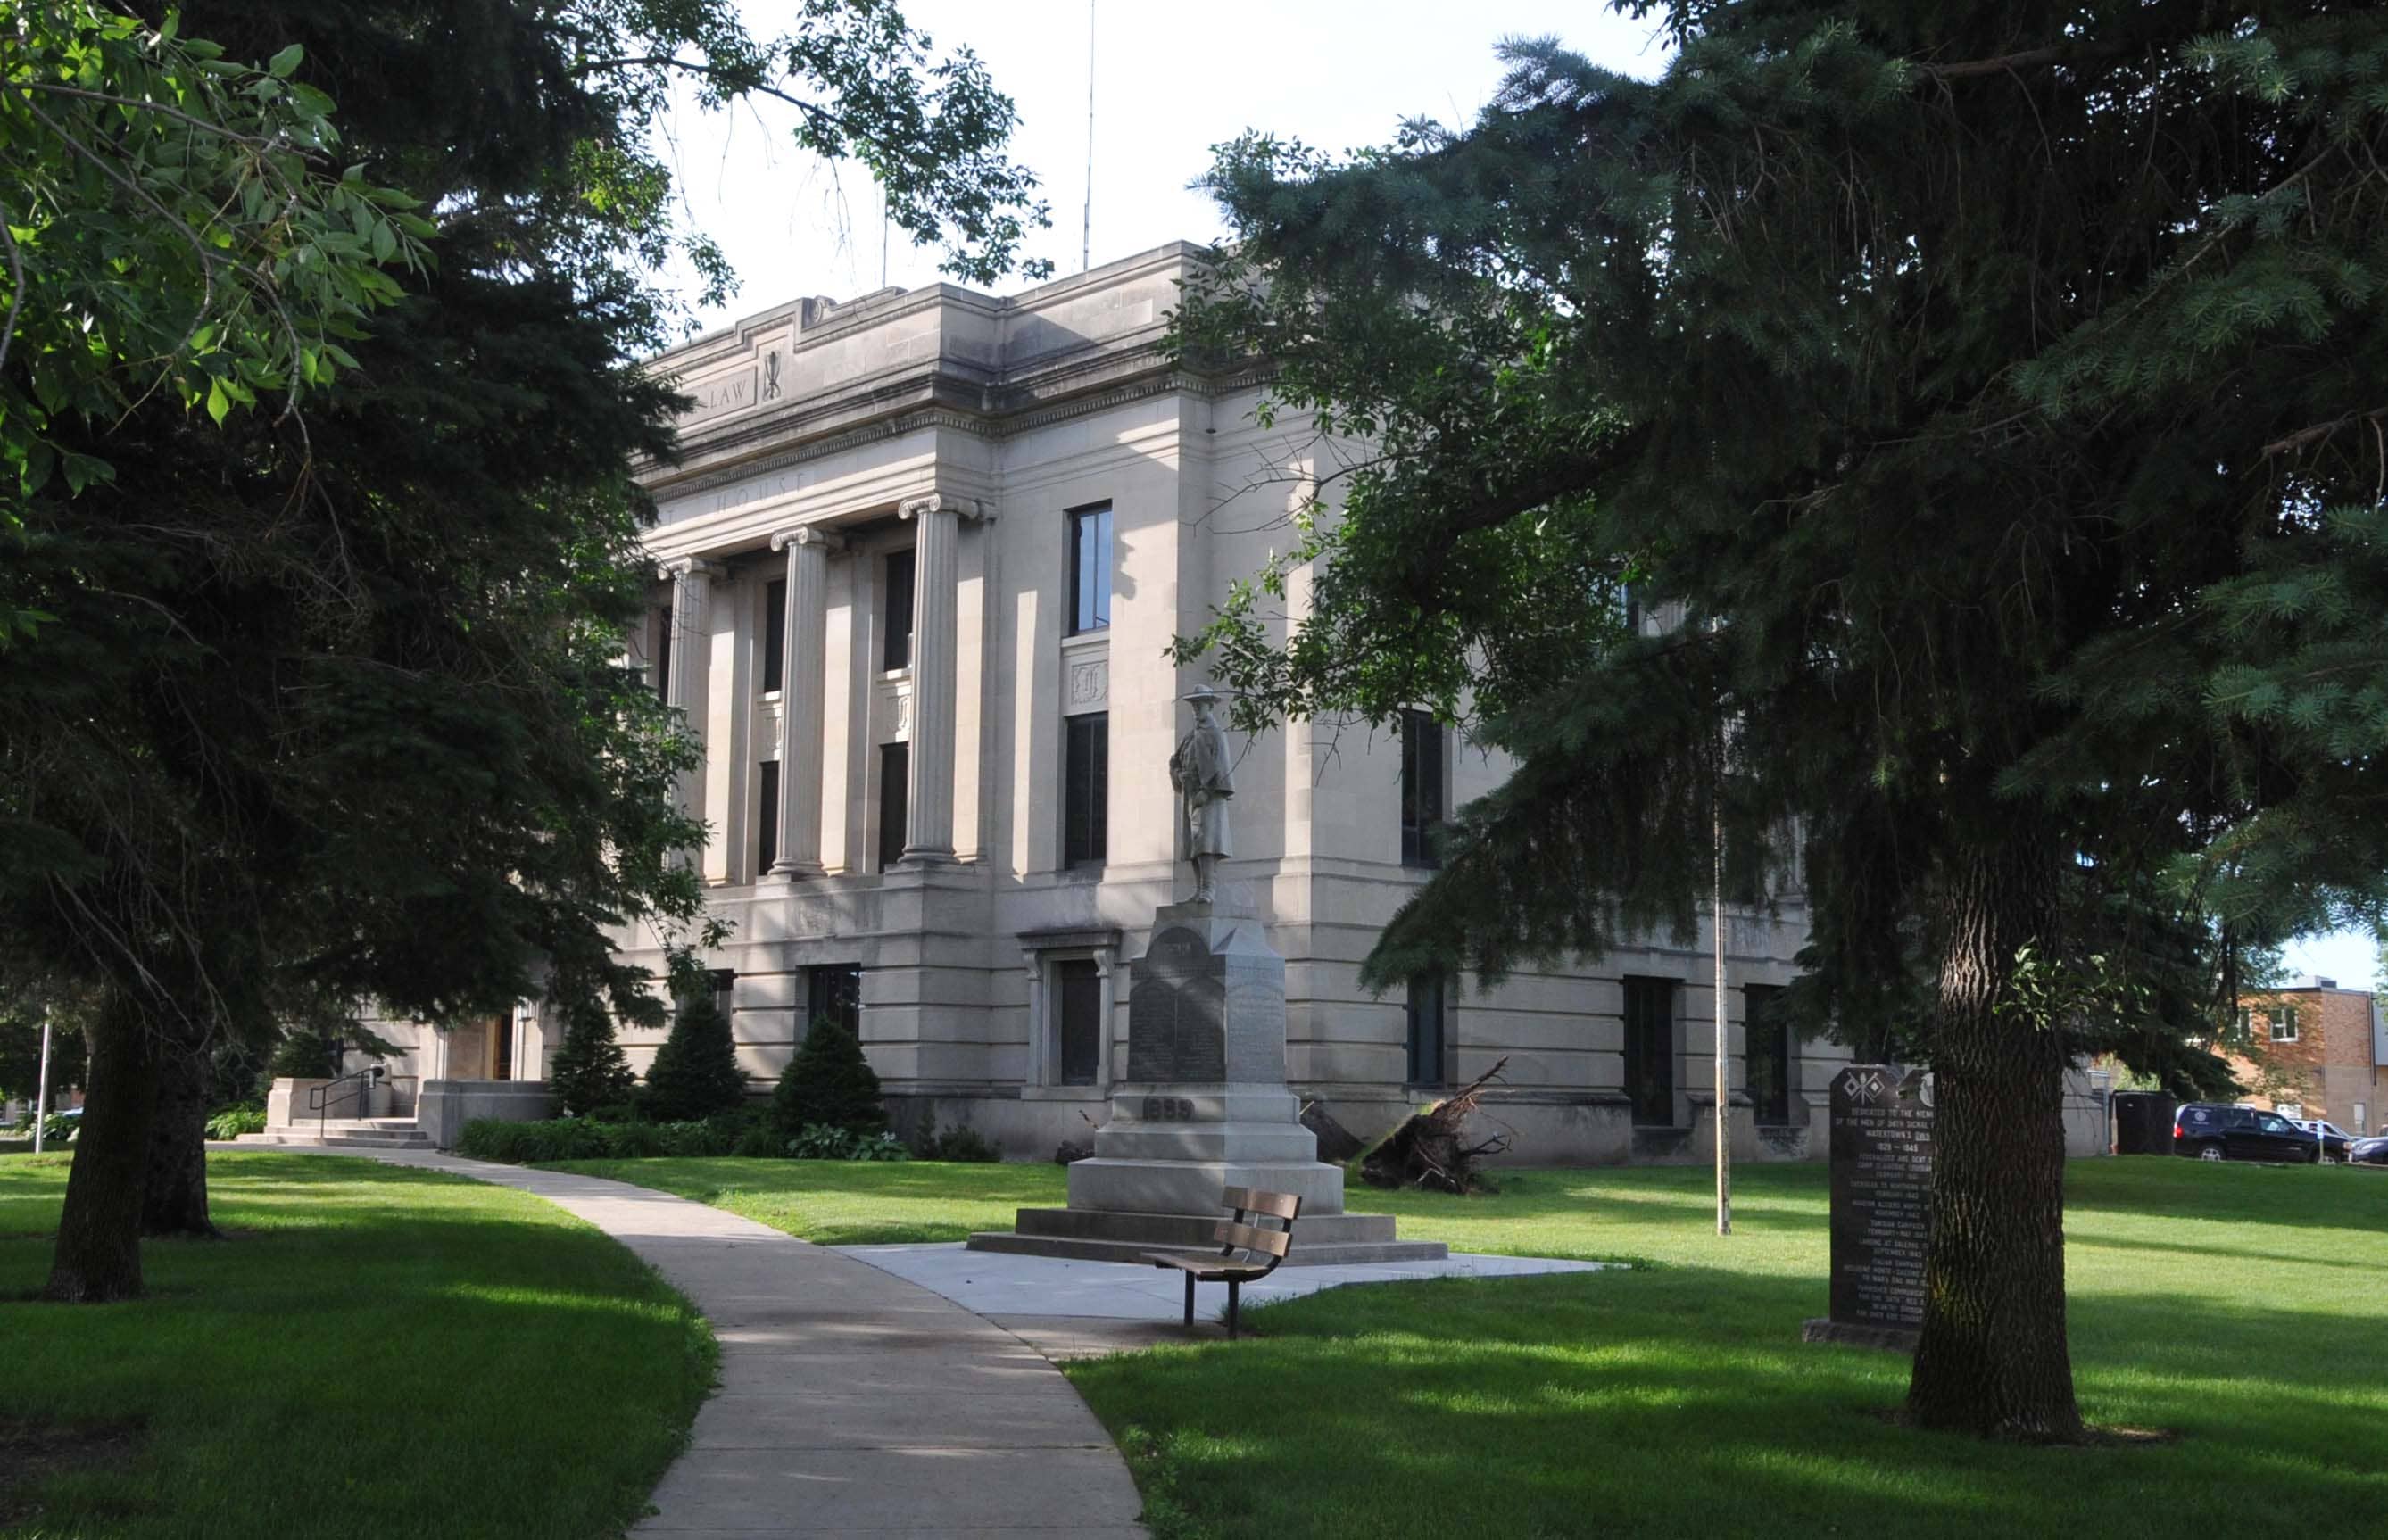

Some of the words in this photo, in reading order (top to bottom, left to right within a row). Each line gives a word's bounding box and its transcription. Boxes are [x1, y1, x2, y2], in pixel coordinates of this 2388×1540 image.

[710, 380, 746, 409] LAW
[717, 473, 808, 513] HOUSE
[1900, 1109, 1912, 1118] THE
